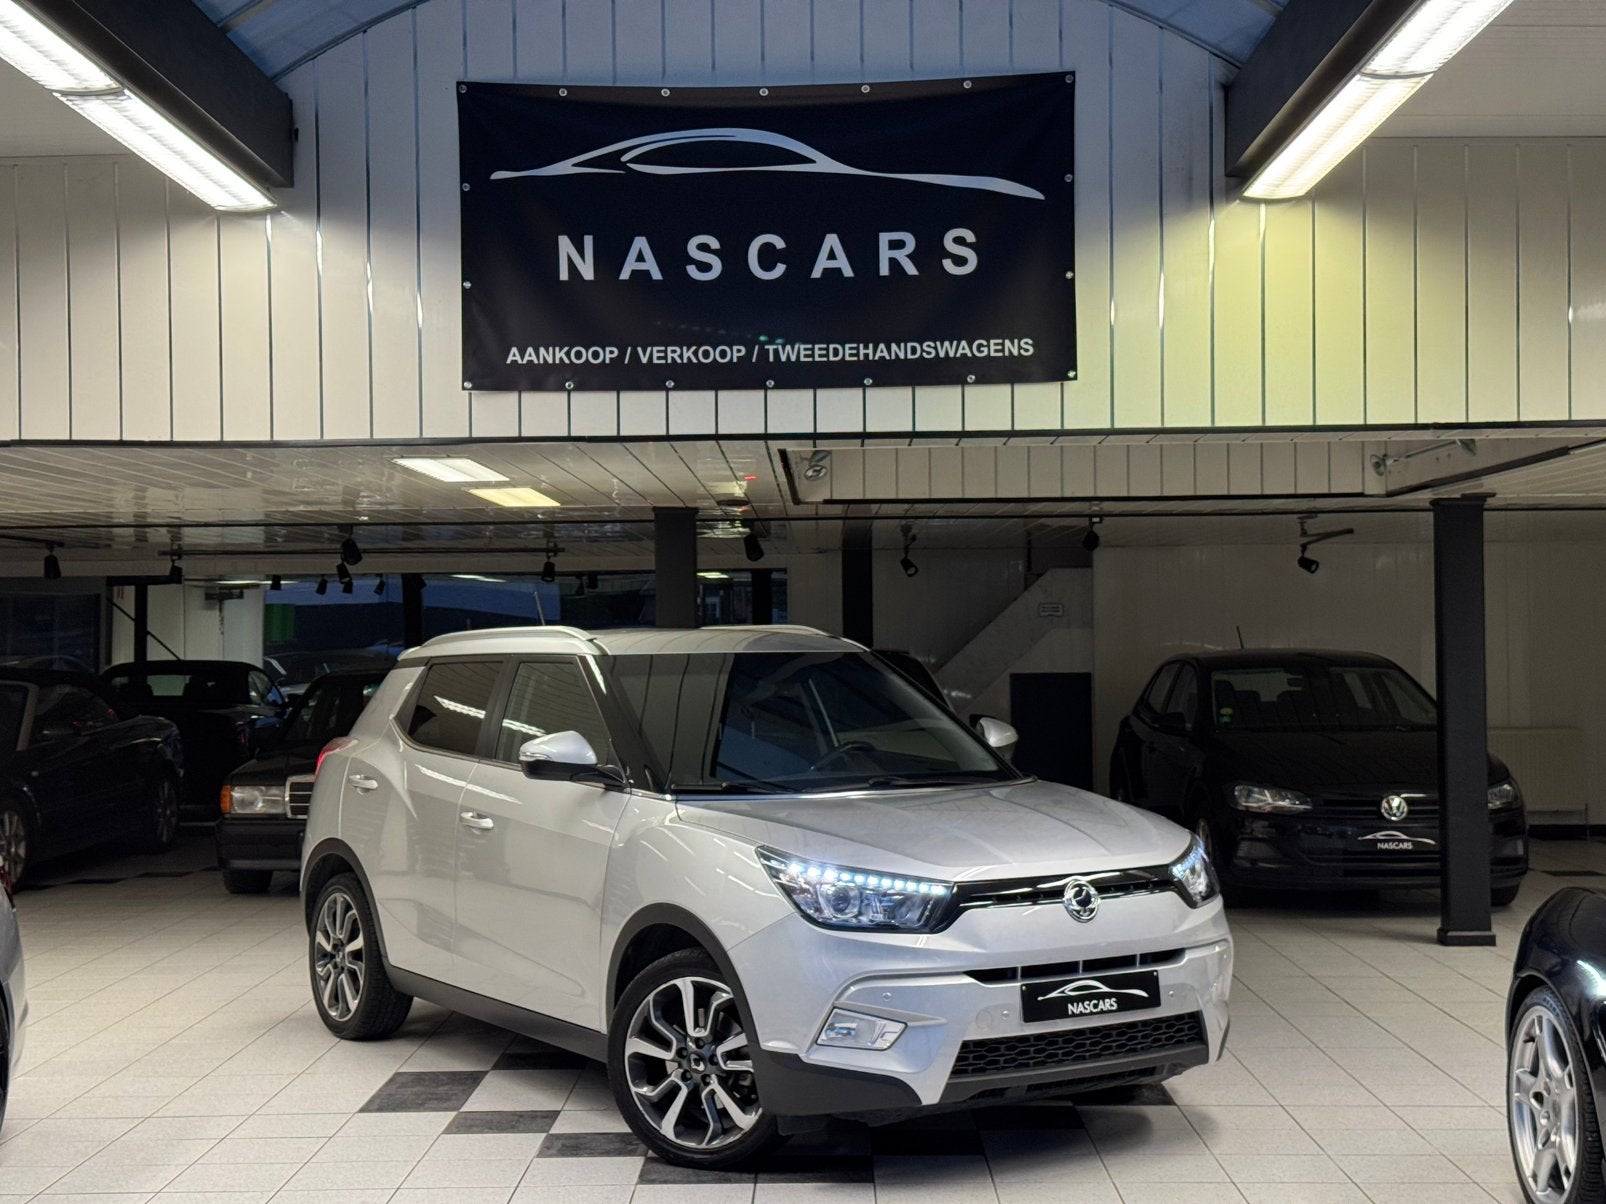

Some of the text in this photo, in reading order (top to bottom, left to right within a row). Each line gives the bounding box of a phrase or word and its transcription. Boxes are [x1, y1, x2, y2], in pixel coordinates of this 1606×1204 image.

[558, 229, 978, 281] NASCARS
[505, 337, 1035, 365] AANKOOP / VERKOOP / TWEEDEHANDSWAGENS
[1377, 841, 1413, 850] NASCARS
[1067, 998, 1118, 1015] NASCARS
